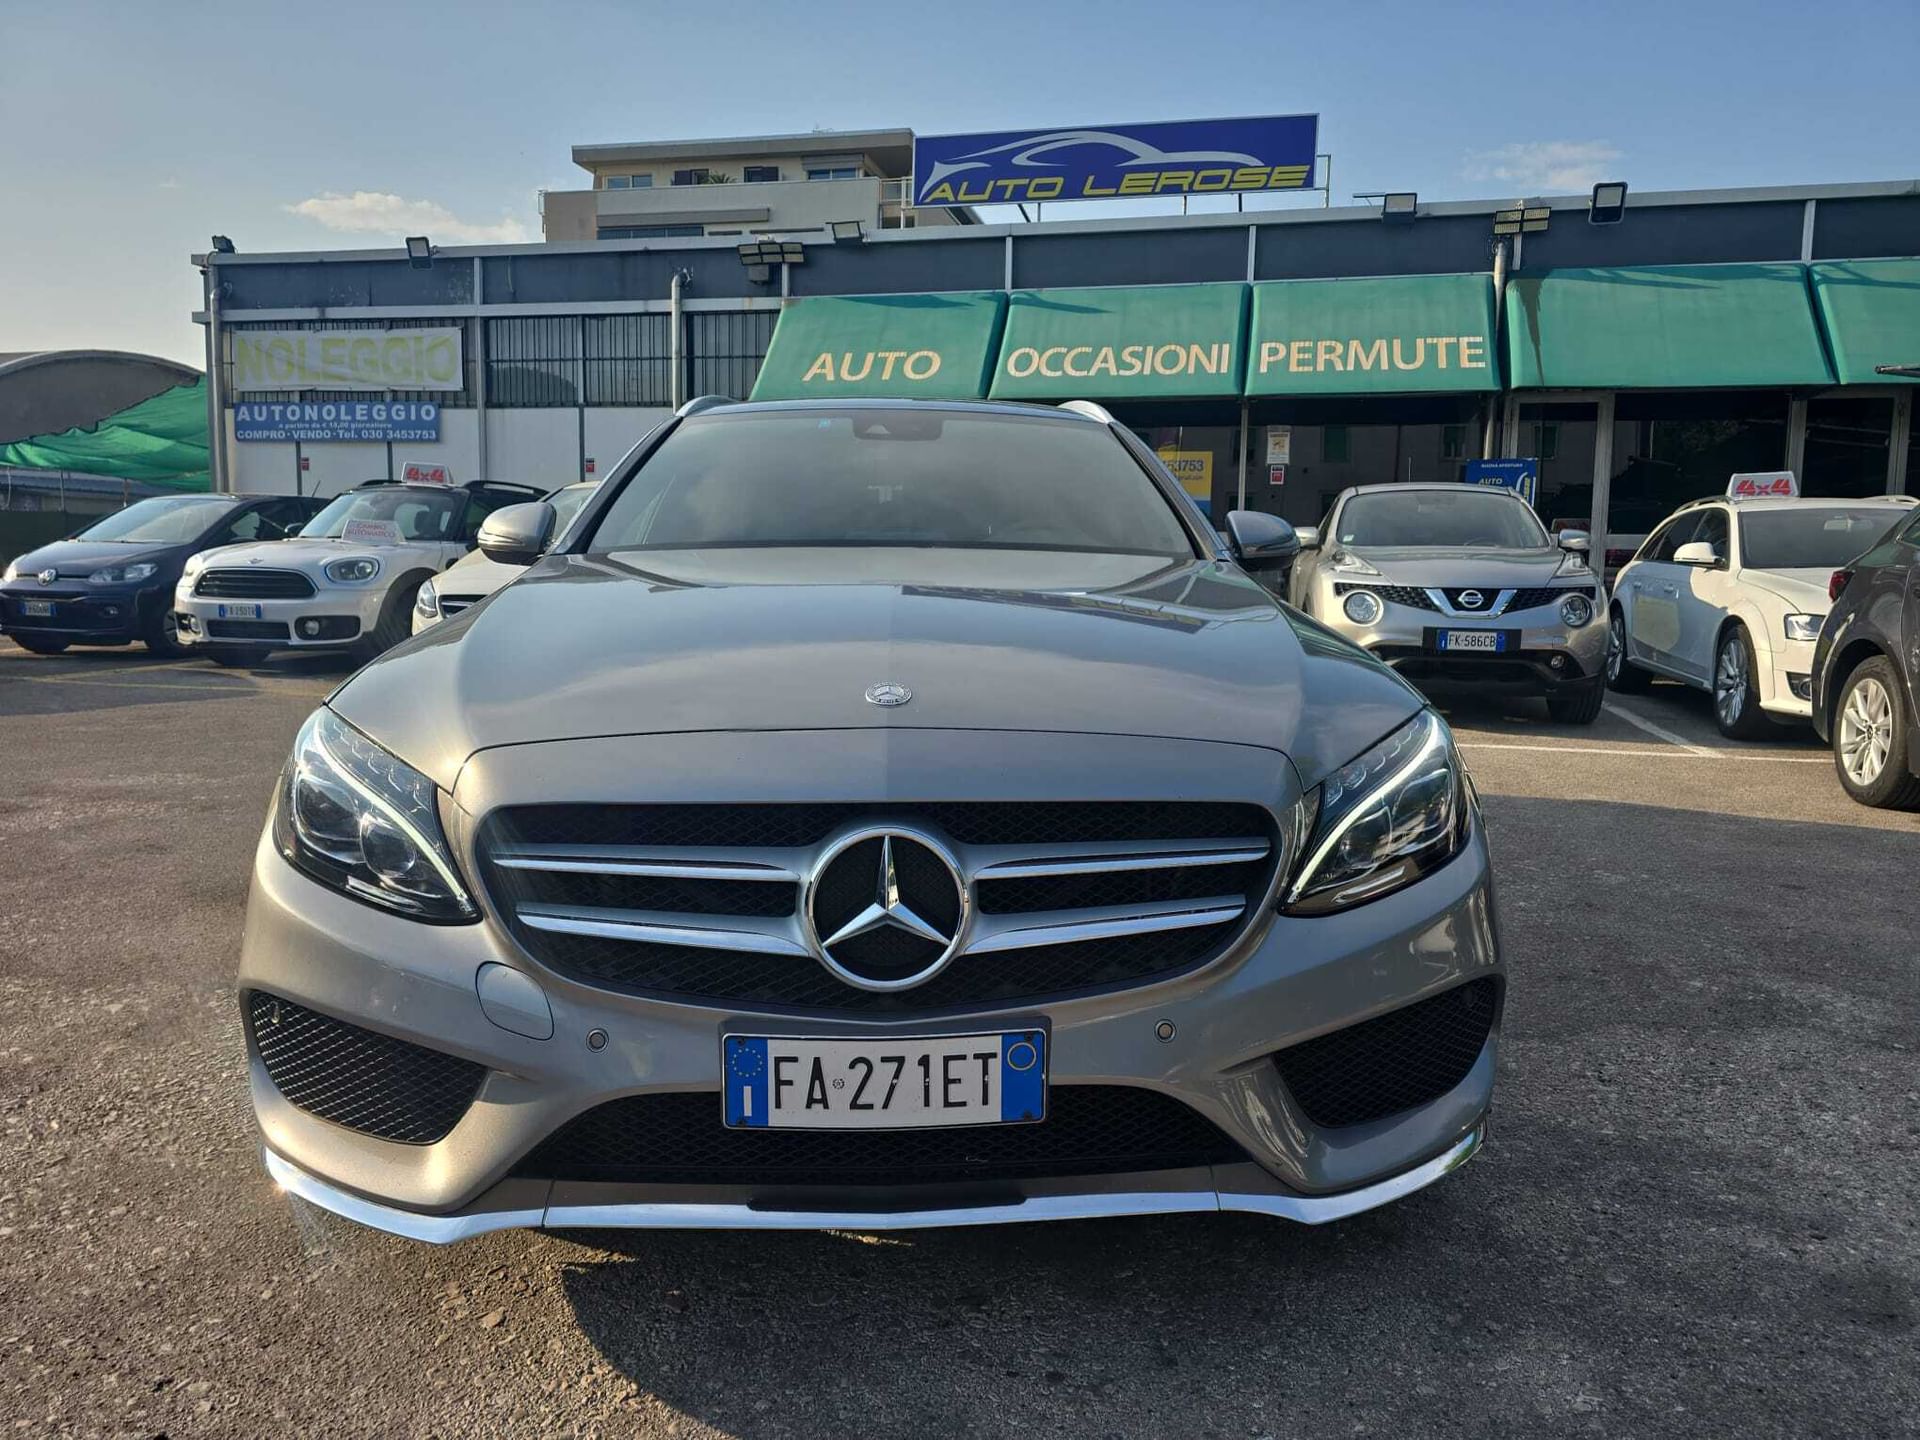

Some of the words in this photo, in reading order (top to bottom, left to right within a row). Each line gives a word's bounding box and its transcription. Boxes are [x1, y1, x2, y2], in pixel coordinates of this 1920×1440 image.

[923, 177, 1065, 203] AUTO
[1082, 165, 1311, 196] LEROSE
[236, 335, 459, 383] NOLEGGIO
[802, 350, 942, 382] AUTO
[1006, 343, 1231, 378] OCCASIONI
[1259, 336, 1486, 374] PERMUTE
[237, 404, 436, 421] AUTONOLEGGIO
[361, 429, 383, 439] 030
[386, 429, 436, 440] 3453753
[1479, 478, 1503, 486] AUTO
[1735, 479, 1792, 497] 4x4
